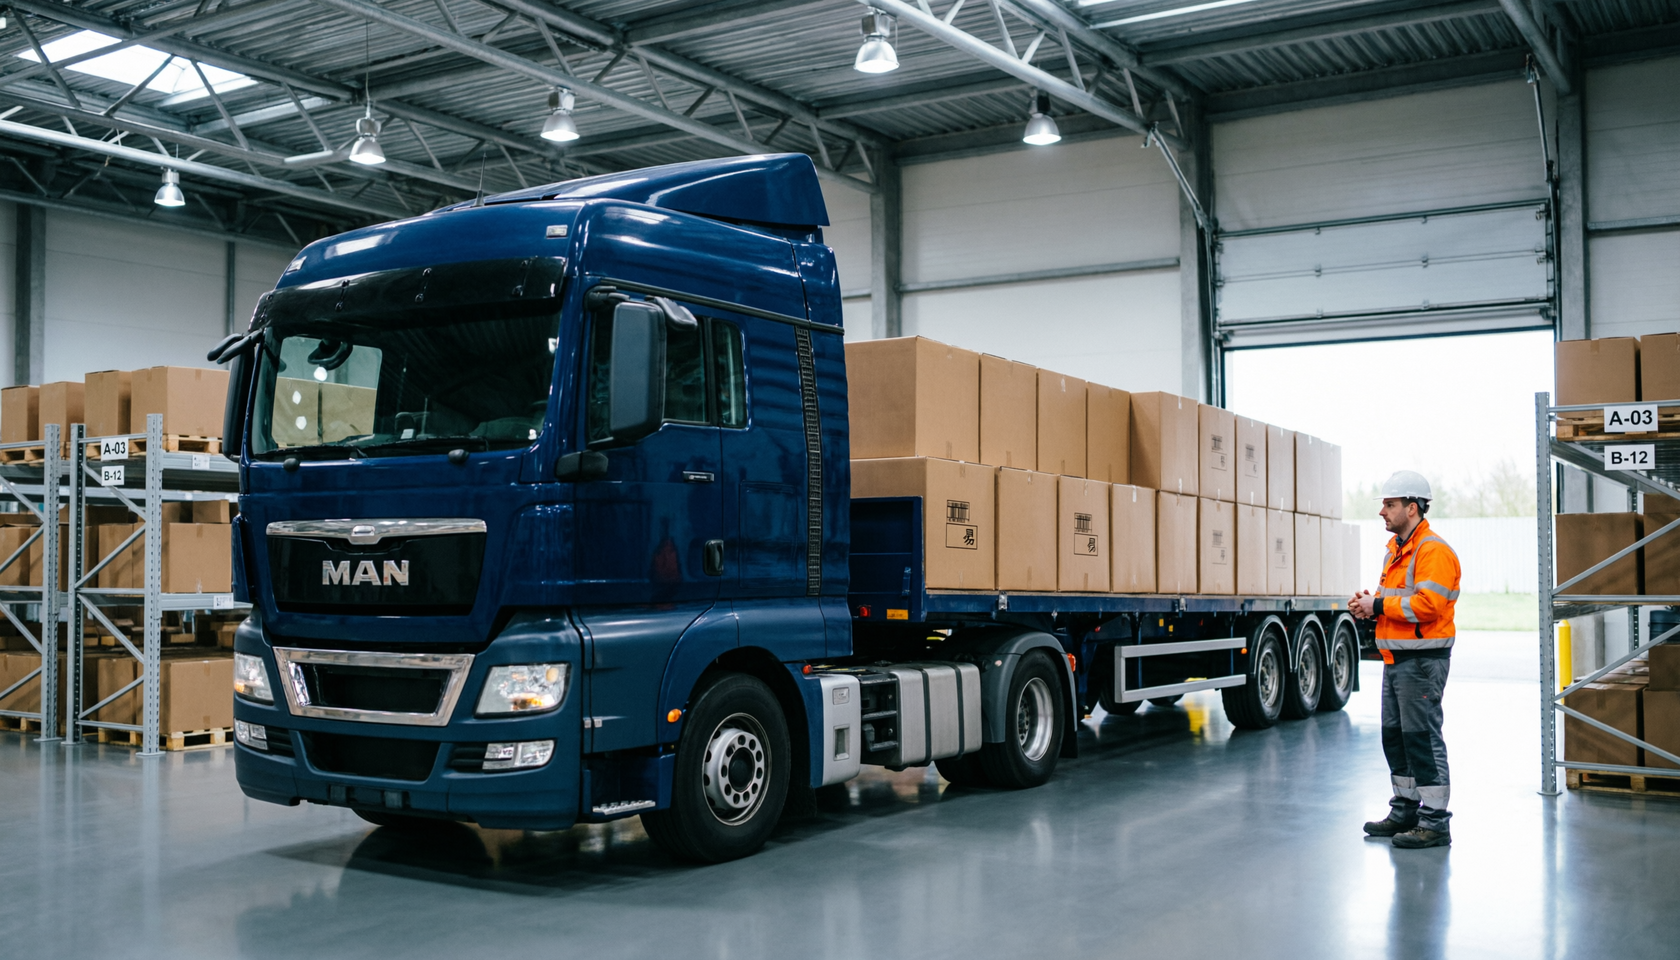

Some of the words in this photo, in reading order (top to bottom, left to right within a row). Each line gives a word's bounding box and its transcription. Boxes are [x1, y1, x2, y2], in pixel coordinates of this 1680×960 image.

[1609, 409, 1653, 426] A-03
[103, 441, 126, 455] A-03
[1611, 450, 1648, 465] B-12
[104, 470, 122, 481] B-12
[322, 560, 409, 586] MAN
